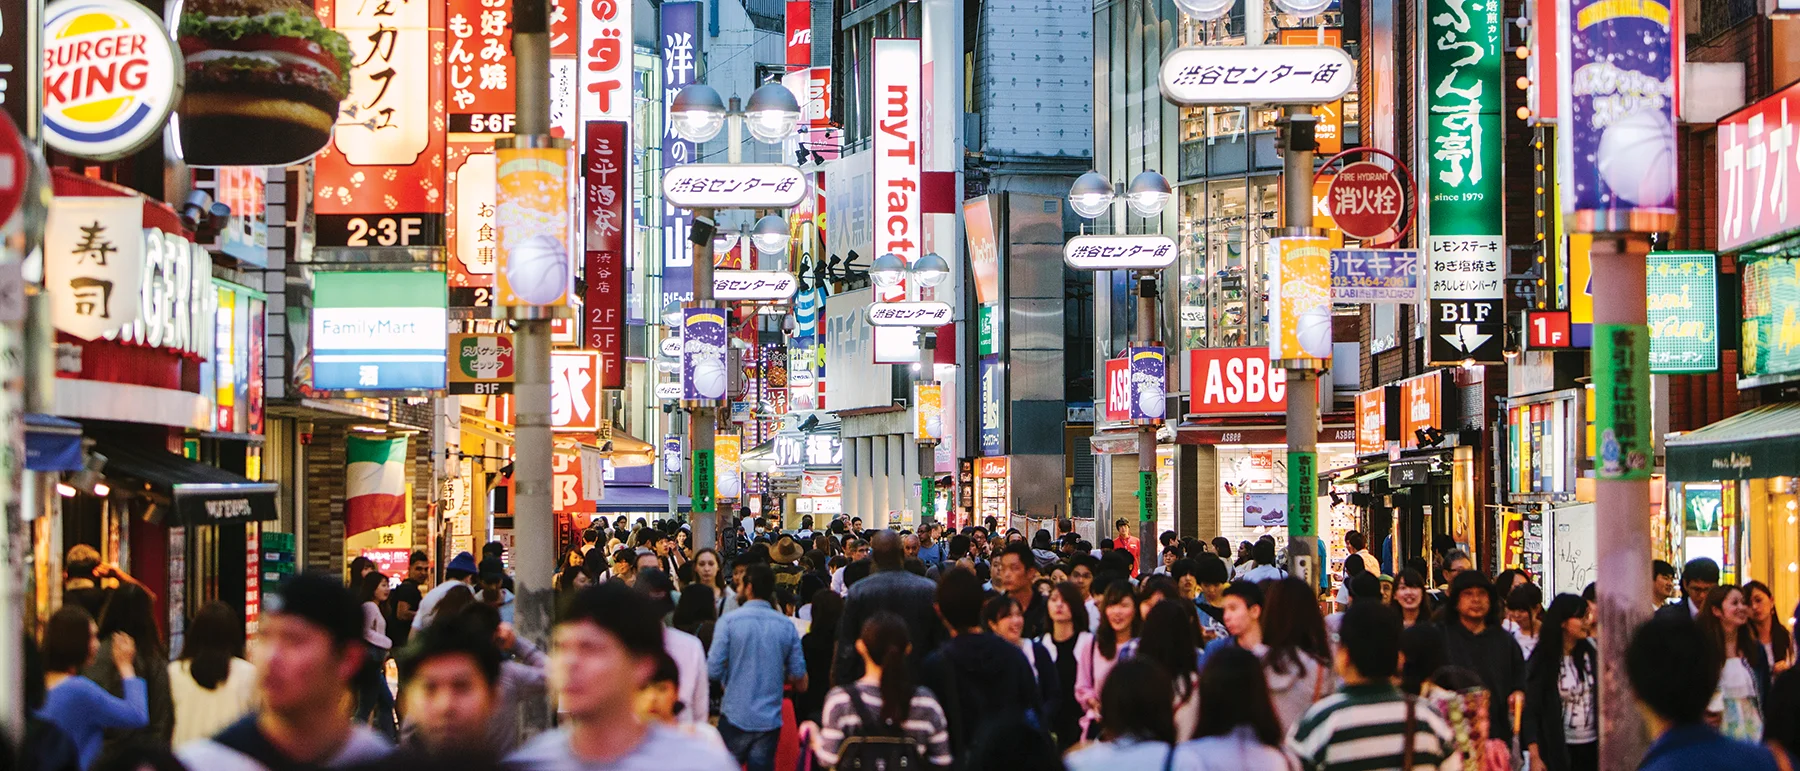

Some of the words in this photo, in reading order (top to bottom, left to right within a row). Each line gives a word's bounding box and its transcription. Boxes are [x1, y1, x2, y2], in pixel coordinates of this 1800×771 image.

[43, 34, 147, 71] BURGER
[43, 58, 149, 107] KING
[1173, 63, 1342, 86] 渋谷センター街
[664, 32, 694, 268] 洋の山
[1340, 172, 1355, 182] FIRE
[1357, 172, 1389, 181] HYDRANT
[1722, 97, 1800, 241] カラオ
[670, 177, 798, 193] 渋谷センター街
[1334, 186, 1397, 215] 消火栓
[1434, 192, 1459, 201] since
[1462, 192, 1484, 202] 1979
[475, 201, 496, 266] お食事
[880, 177, 916, 303] facty
[1071, 244, 1172, 258] 渋谷センター街
[1434, 240, 1498, 252] レモンステーキ
[71, 220, 118, 319] 寿司
[596, 253, 611, 294] 渋谷店
[1434, 260, 1497, 273] ねぎ塩焼き
[873, 308, 947, 319] 渋谷センター街
[1440, 303, 1492, 323] B1F
[322, 319, 416, 338] FamilyMart
[1534, 317, 1562, 345] 1F
[359, 364, 379, 387] 酒
[474, 383, 500, 395] B1F
